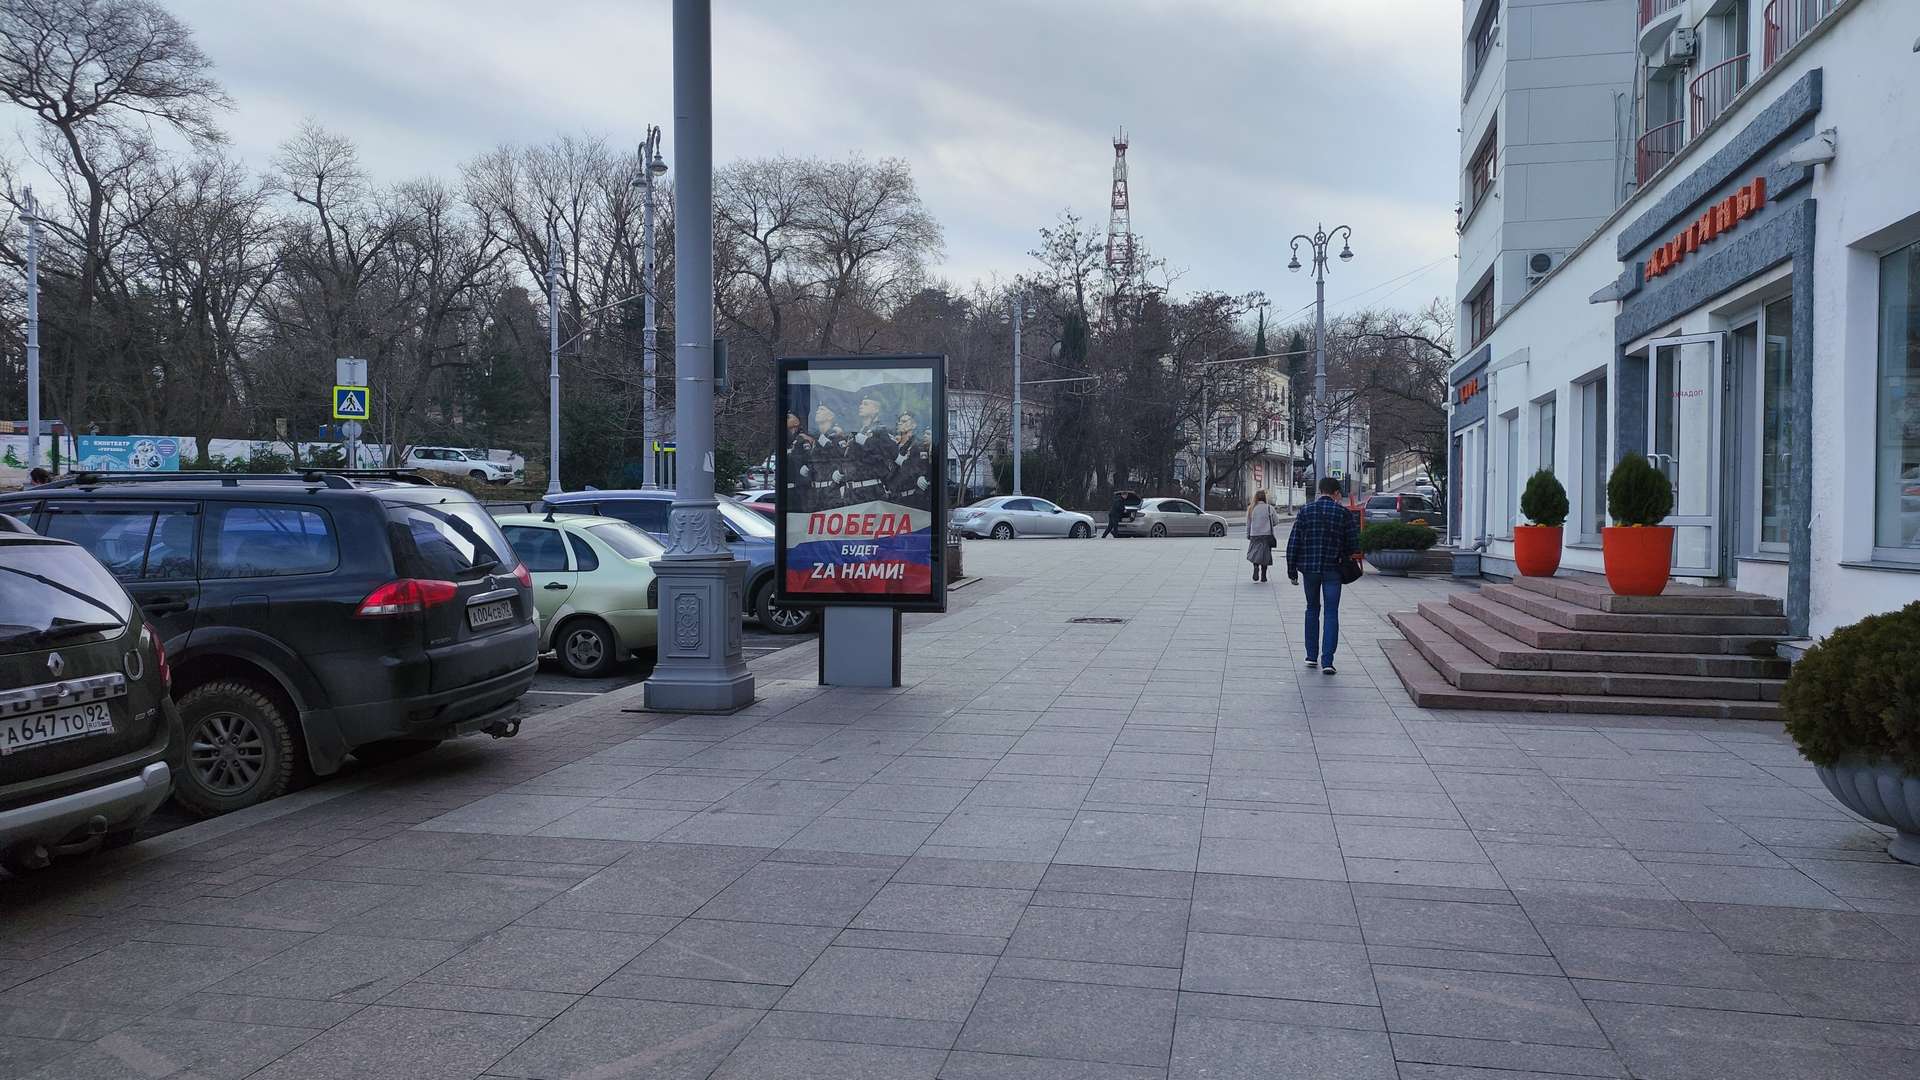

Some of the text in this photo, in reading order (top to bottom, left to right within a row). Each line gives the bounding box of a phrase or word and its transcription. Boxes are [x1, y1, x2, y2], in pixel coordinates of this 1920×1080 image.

[808, 513, 912, 539] ПОБЕДА
[841, 544, 879, 557] БУДЕТ
[811, 562, 905, 580] ZА НАМИ!
[0, 686, 126, 713] USTER
[86, 705, 105, 722] 92
